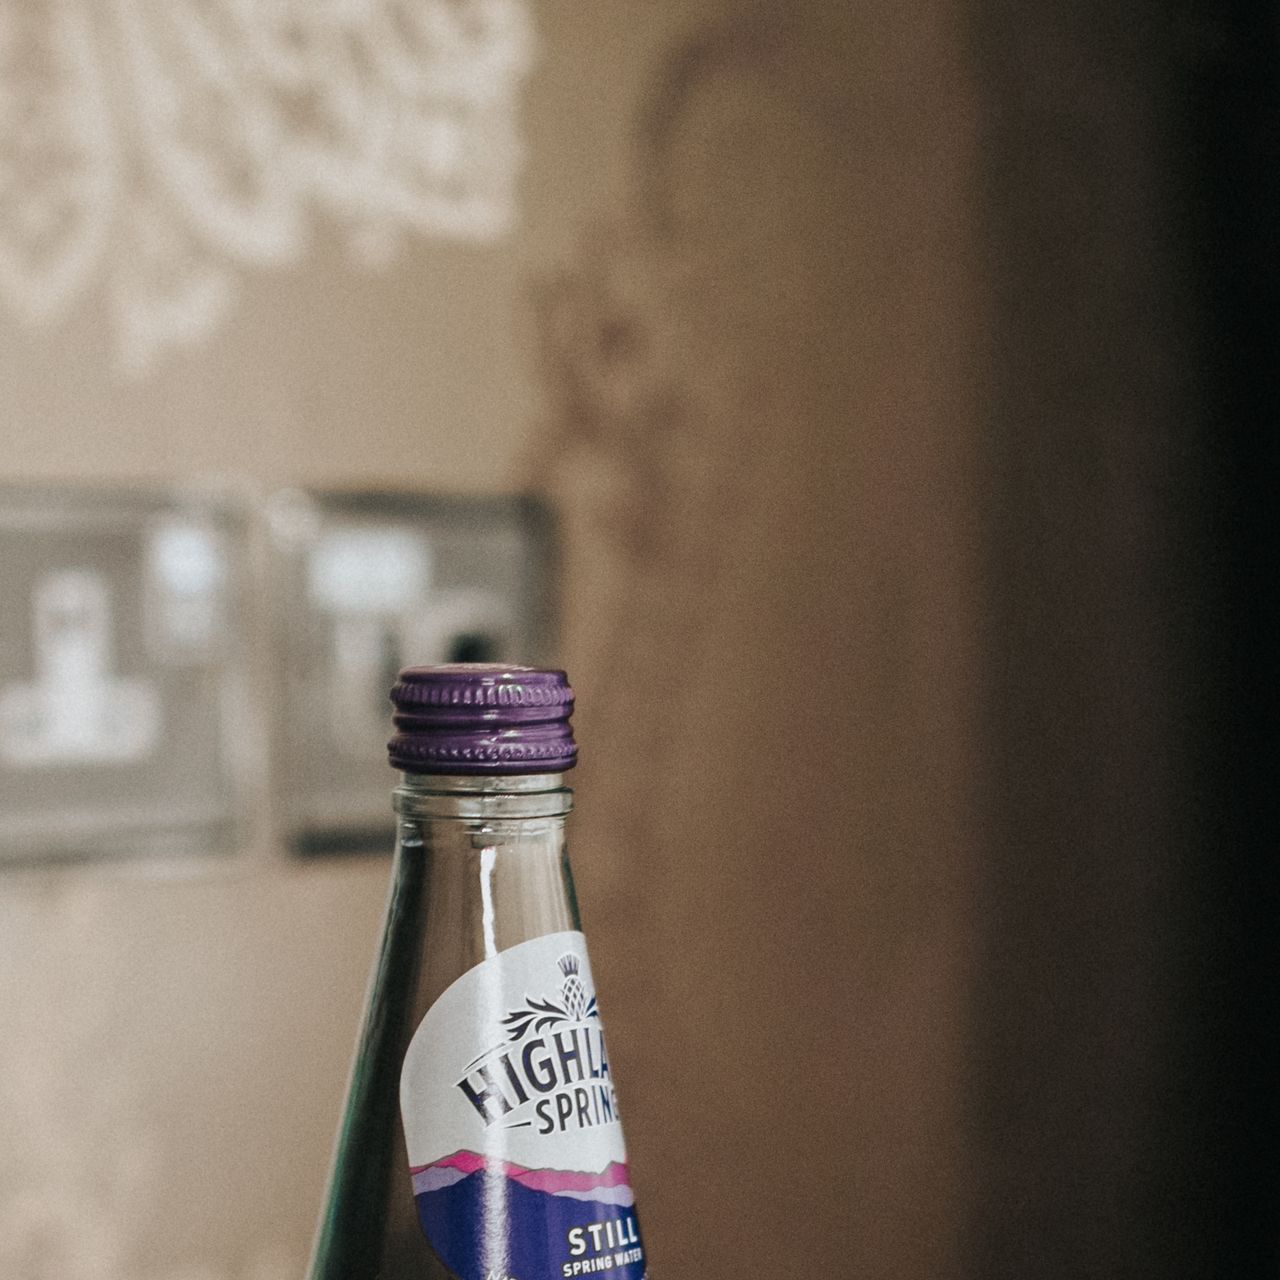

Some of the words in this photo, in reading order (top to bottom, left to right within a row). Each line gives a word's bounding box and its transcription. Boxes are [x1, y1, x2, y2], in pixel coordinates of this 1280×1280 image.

[568, 1217, 638, 1256] STILL
[562, 1255, 613, 1278] SPRING
[614, 1247, 643, 1267] WATER
